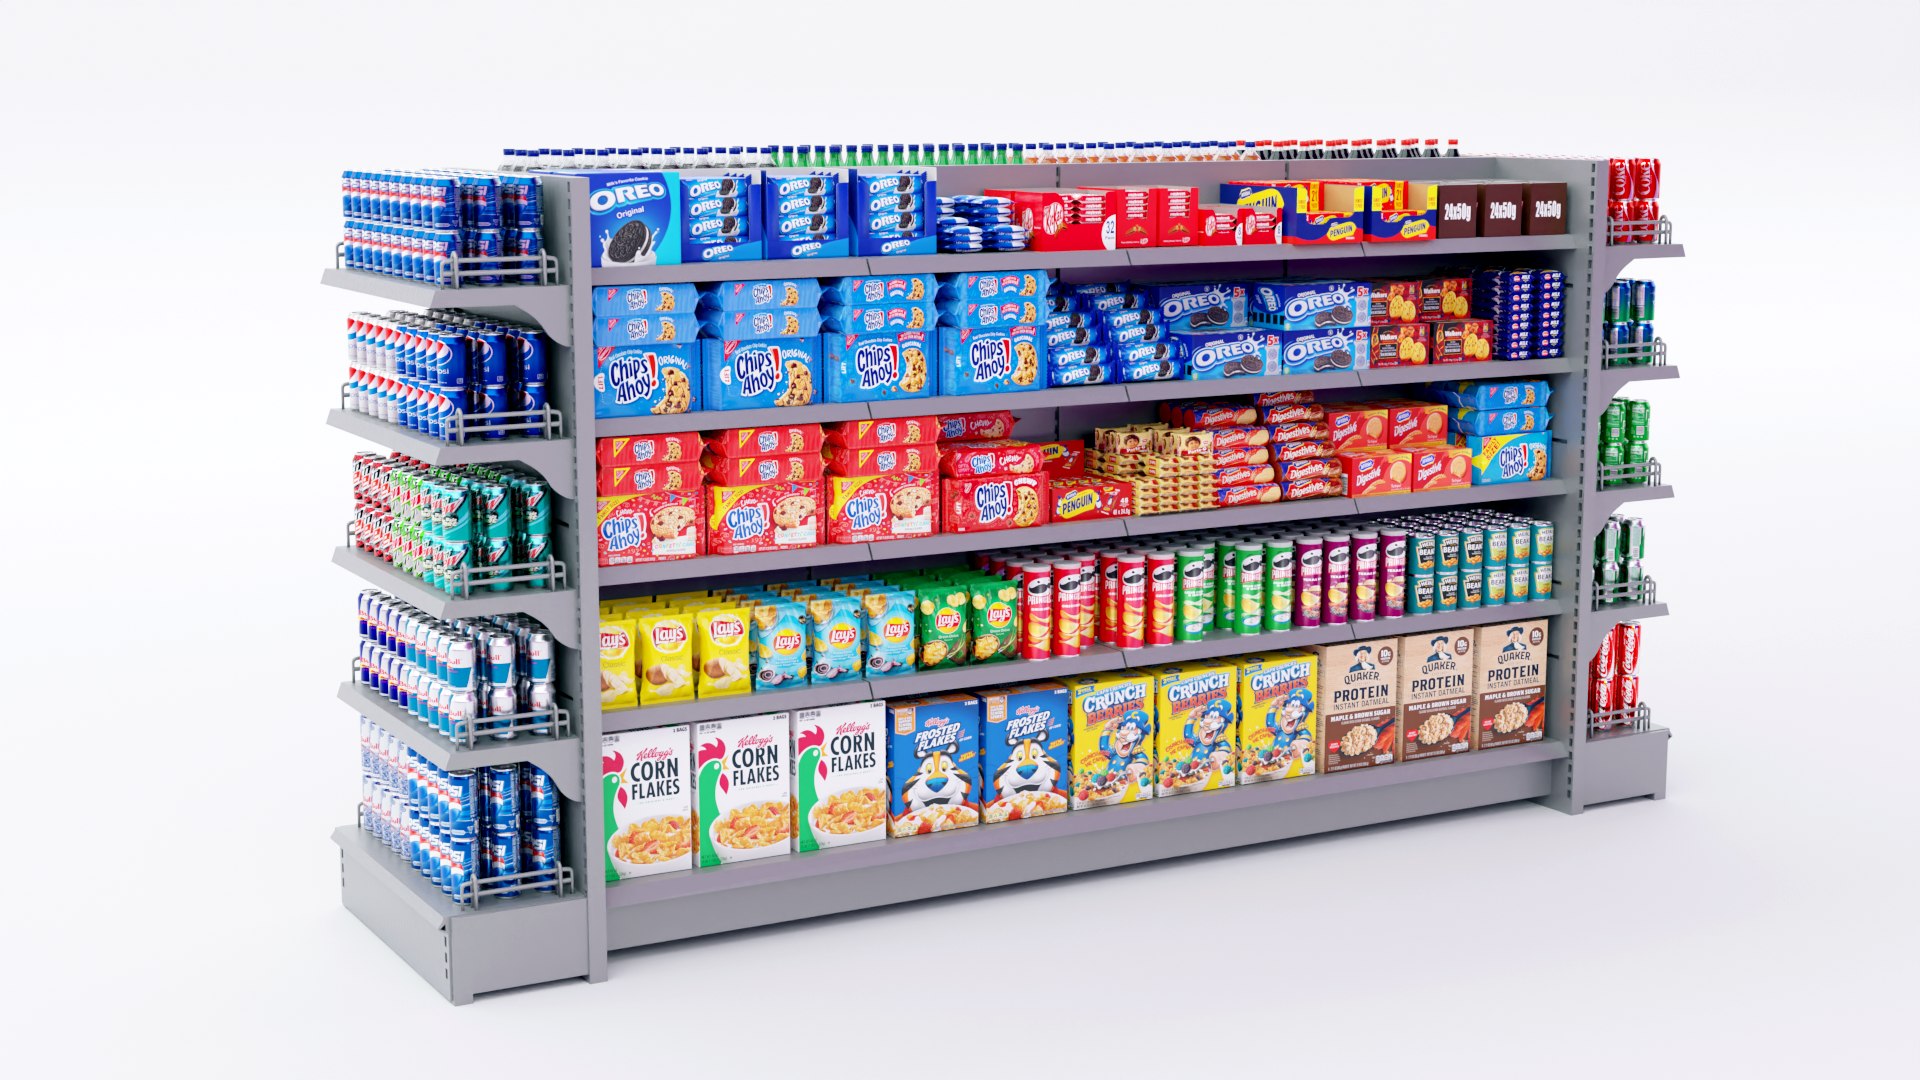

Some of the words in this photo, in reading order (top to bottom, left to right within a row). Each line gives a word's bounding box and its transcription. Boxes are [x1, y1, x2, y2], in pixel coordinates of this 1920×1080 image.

[690, 181, 721, 198] OREO
[780, 180, 809, 195] OREO
[869, 178, 899, 193] OREO
[590, 184, 664, 211] OREO
[870, 196, 899, 211] OREO
[616, 206, 644, 219] Original
[691, 200, 722, 216] OREO
[780, 198, 810, 214] OREO
[1444, 203, 1471, 222] 24x50g
[1490, 202, 1516, 220] 24x50g
[1535, 201, 1561, 218] 24x50g
[1106, 220, 1114, 234] 32
[1330, 226, 1352, 237] PENGUIN
[1404, 223, 1426, 235] PENGUIN
[703, 245, 733, 259] OREO
[792, 242, 821, 256] OREO
[881, 240, 910, 254] OREO
[1233, 288, 1245, 298] 5x
[1358, 287, 1368, 297] 5x
[1164, 294, 1219, 318] OREO
[1288, 294, 1344, 316] OREO
[1114, 313, 1140, 327] OREO
[1119, 328, 1145, 342] OREO
[1267, 336, 1279, 345] 5x
[1356, 331, 1367, 340] 5x
[782, 349, 810, 362] ORIGINAL
[972, 342, 1003, 367] Chips
[1129, 347, 1156, 362] OREO
[1195, 341, 1253, 367] OREO
[1287, 337, 1343, 360] OREO
[658, 356, 688, 370] ORIGINAL
[737, 352, 772, 379] Chips
[858, 347, 890, 373] Chips
[611, 358, 648, 386] Chips
[1062, 369, 1089, 384] OREO
[1133, 364, 1160, 380] OREO
[1205, 411, 1233, 424] Digestives
[1216, 432, 1245, 446] Digestives
[1278, 426, 1310, 440] Digestives
[1283, 445, 1316, 460] Digestives
[1501, 448, 1522, 466] Chips
[972, 456, 990, 468] Chips
[1290, 464, 1323, 479] Digestives
[977, 484, 1006, 507] Chips
[1228, 489, 1257, 503] Digestives
[1291, 482, 1324, 496] Digestives
[847, 498, 879, 520] Chips
[1062, 494, 1093, 514] PENGUIN
[728, 507, 761, 528] Chips
[603, 517, 637, 541] Chips
[937, 612, 960, 628] Lay's
[989, 607, 1011, 621] Lay's
[655, 626, 686, 644] Lay's
[713, 620, 743, 637] Lay's
[830, 628, 856, 643] Lay's
[885, 622, 910, 637] Lay's
[775, 635, 800, 649] Lay's
[1498, 652, 1530, 664] QUAKER
[1422, 662, 1456, 674] QUAKER
[1488, 664, 1539, 681] PROTEIN
[1252, 662, 1310, 691] CRUNCH
[1344, 672, 1379, 684] QUAKER
[1412, 674, 1464, 692] PROTEIN
[1488, 680, 1511, 689] INSTANT
[1514, 677, 1539, 685] OATMEAL
[1169, 673, 1229, 702] CRUNCH
[1254, 676, 1308, 704] BERRIES
[1334, 684, 1389, 703] PROTEIN
[1412, 691, 1436, 700] INSTANT
[1439, 686, 1465, 696] OATMEAL
[1084, 683, 1146, 713] CRUNCH
[1172, 687, 1227, 715] BERRIES
[1485, 692, 1501, 700] MAPLE
[1334, 701, 1358, 711] INSTANT
[1362, 697, 1389, 707] OATMEAL
[1408, 703, 1426, 711] MAPLE
[1431, 700, 1450, 708] BROWN
[1087, 698, 1144, 727] BERRIES
[1331, 714, 1348, 722] MAPLE
[836, 722, 870, 734] Kellogg's
[1006, 711, 1050, 731] FROSTED
[915, 722, 960, 743] FROSTED
[1009, 721, 1046, 739] FLAKES
[738, 735, 773, 747] Kellogg's
[831, 732, 875, 755] CORN
[918, 732, 957, 751] FLAKES
[636, 747, 673, 760] Kellogg's
[732, 745, 778, 768] CORN
[832, 752, 876, 772] FLAKES
[631, 758, 678, 782] CORN
[733, 765, 779, 786] FLAKES
[632, 779, 680, 800] FLAKES
